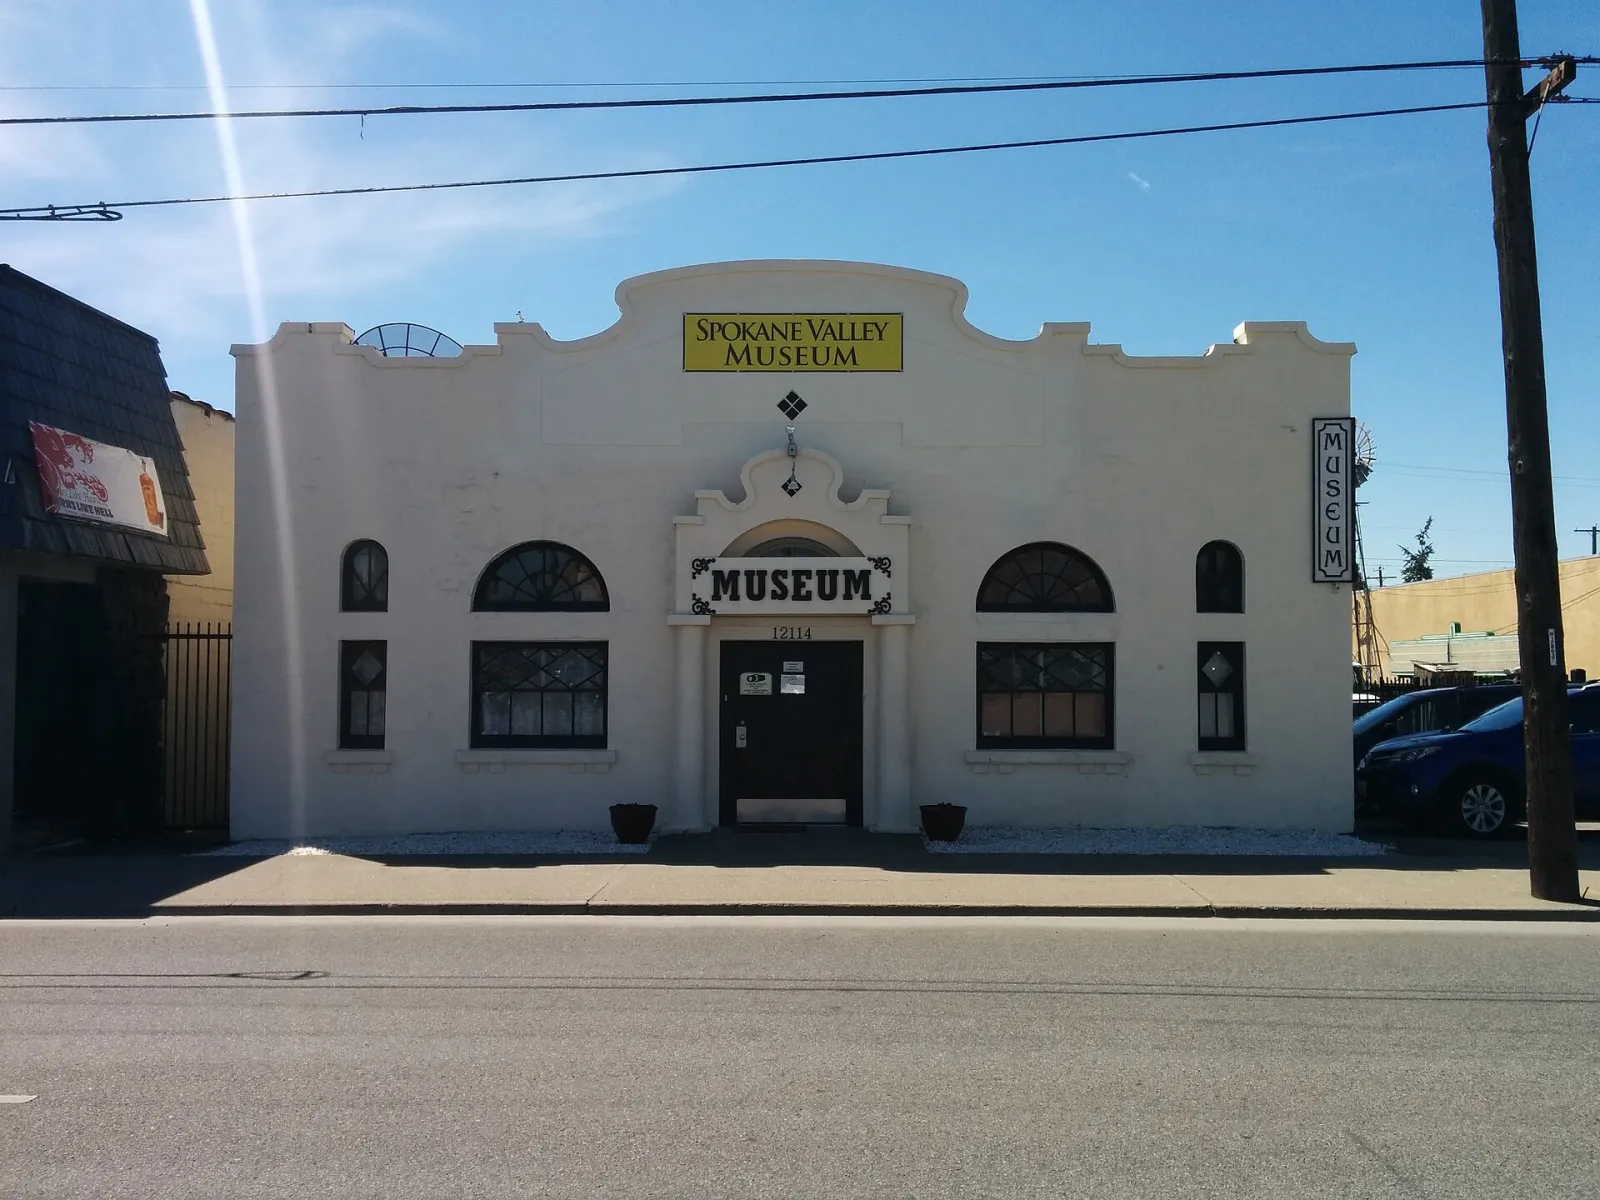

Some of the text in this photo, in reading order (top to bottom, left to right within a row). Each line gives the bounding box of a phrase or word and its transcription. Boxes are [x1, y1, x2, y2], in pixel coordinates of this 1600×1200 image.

[696, 318, 890, 341] SPOKANE VALLEY
[724, 343, 859, 366] MUSEUM
[1324, 432, 1343, 568] MUSEUM
[711, 569, 872, 601] MUSEUM
[772, 626, 812, 640] 12114
